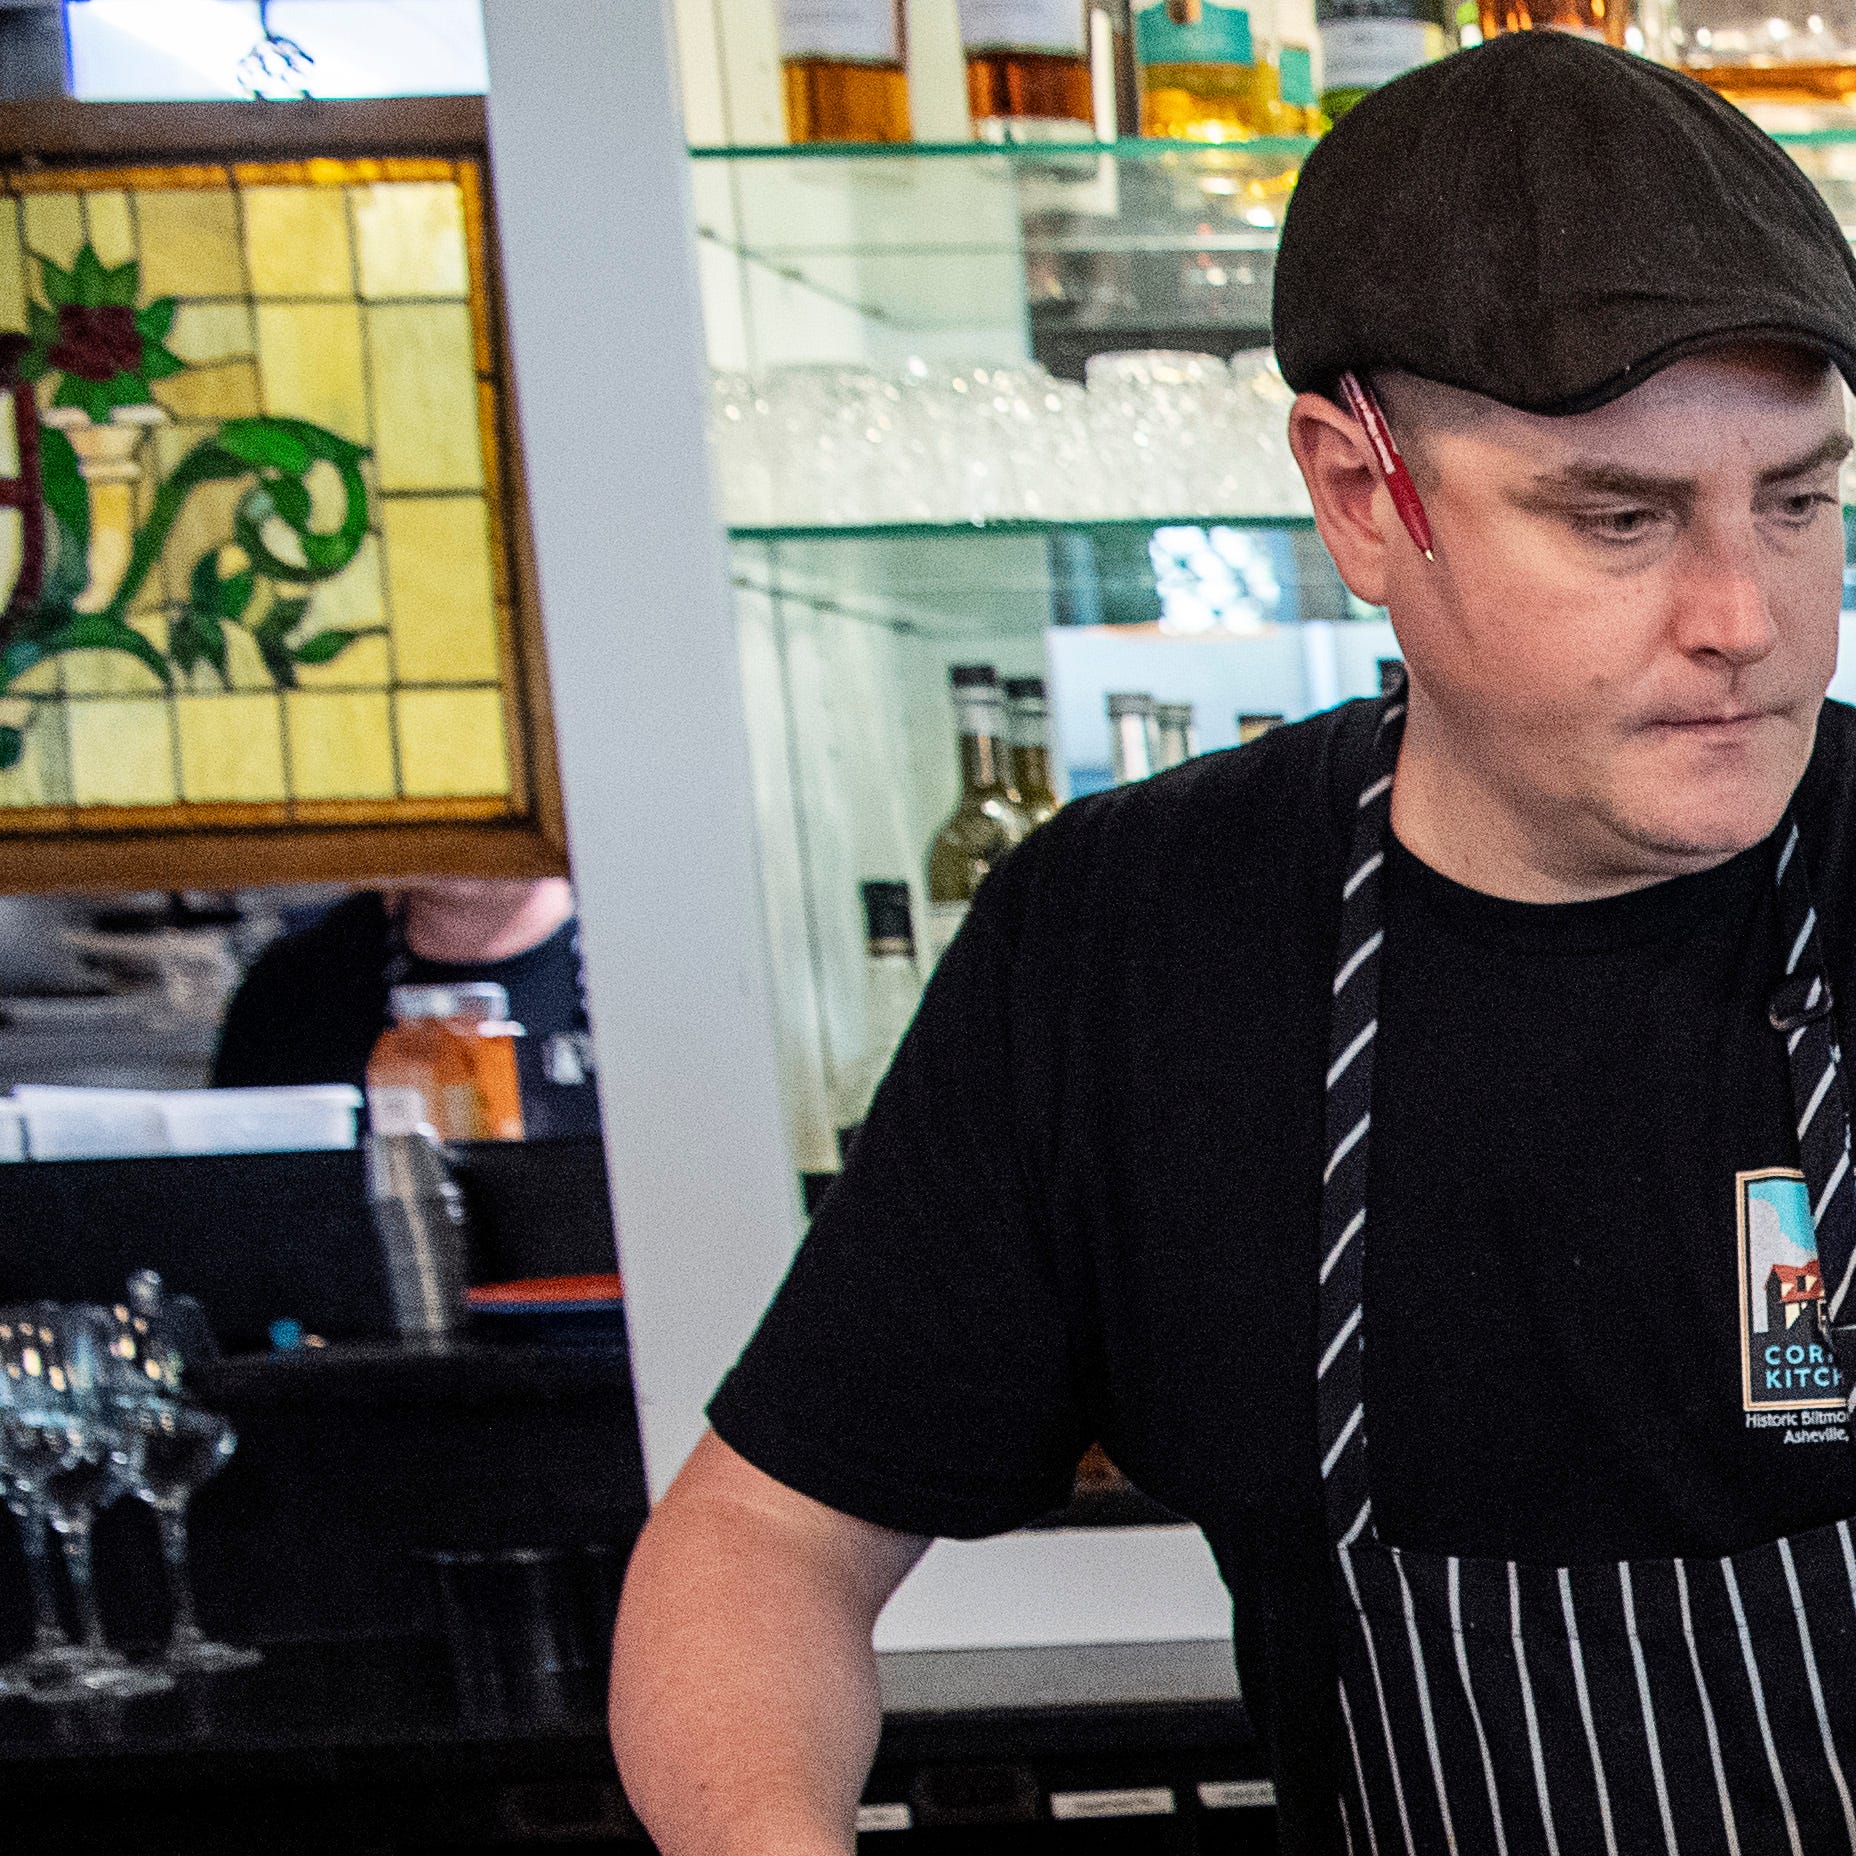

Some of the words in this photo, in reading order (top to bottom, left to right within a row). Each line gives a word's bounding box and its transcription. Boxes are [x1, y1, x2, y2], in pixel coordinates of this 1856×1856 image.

[1765, 1344, 1833, 1365] COR
[1745, 1413, 1798, 1428] Historic
[1801, 1411, 1850, 1426] Biltmo
